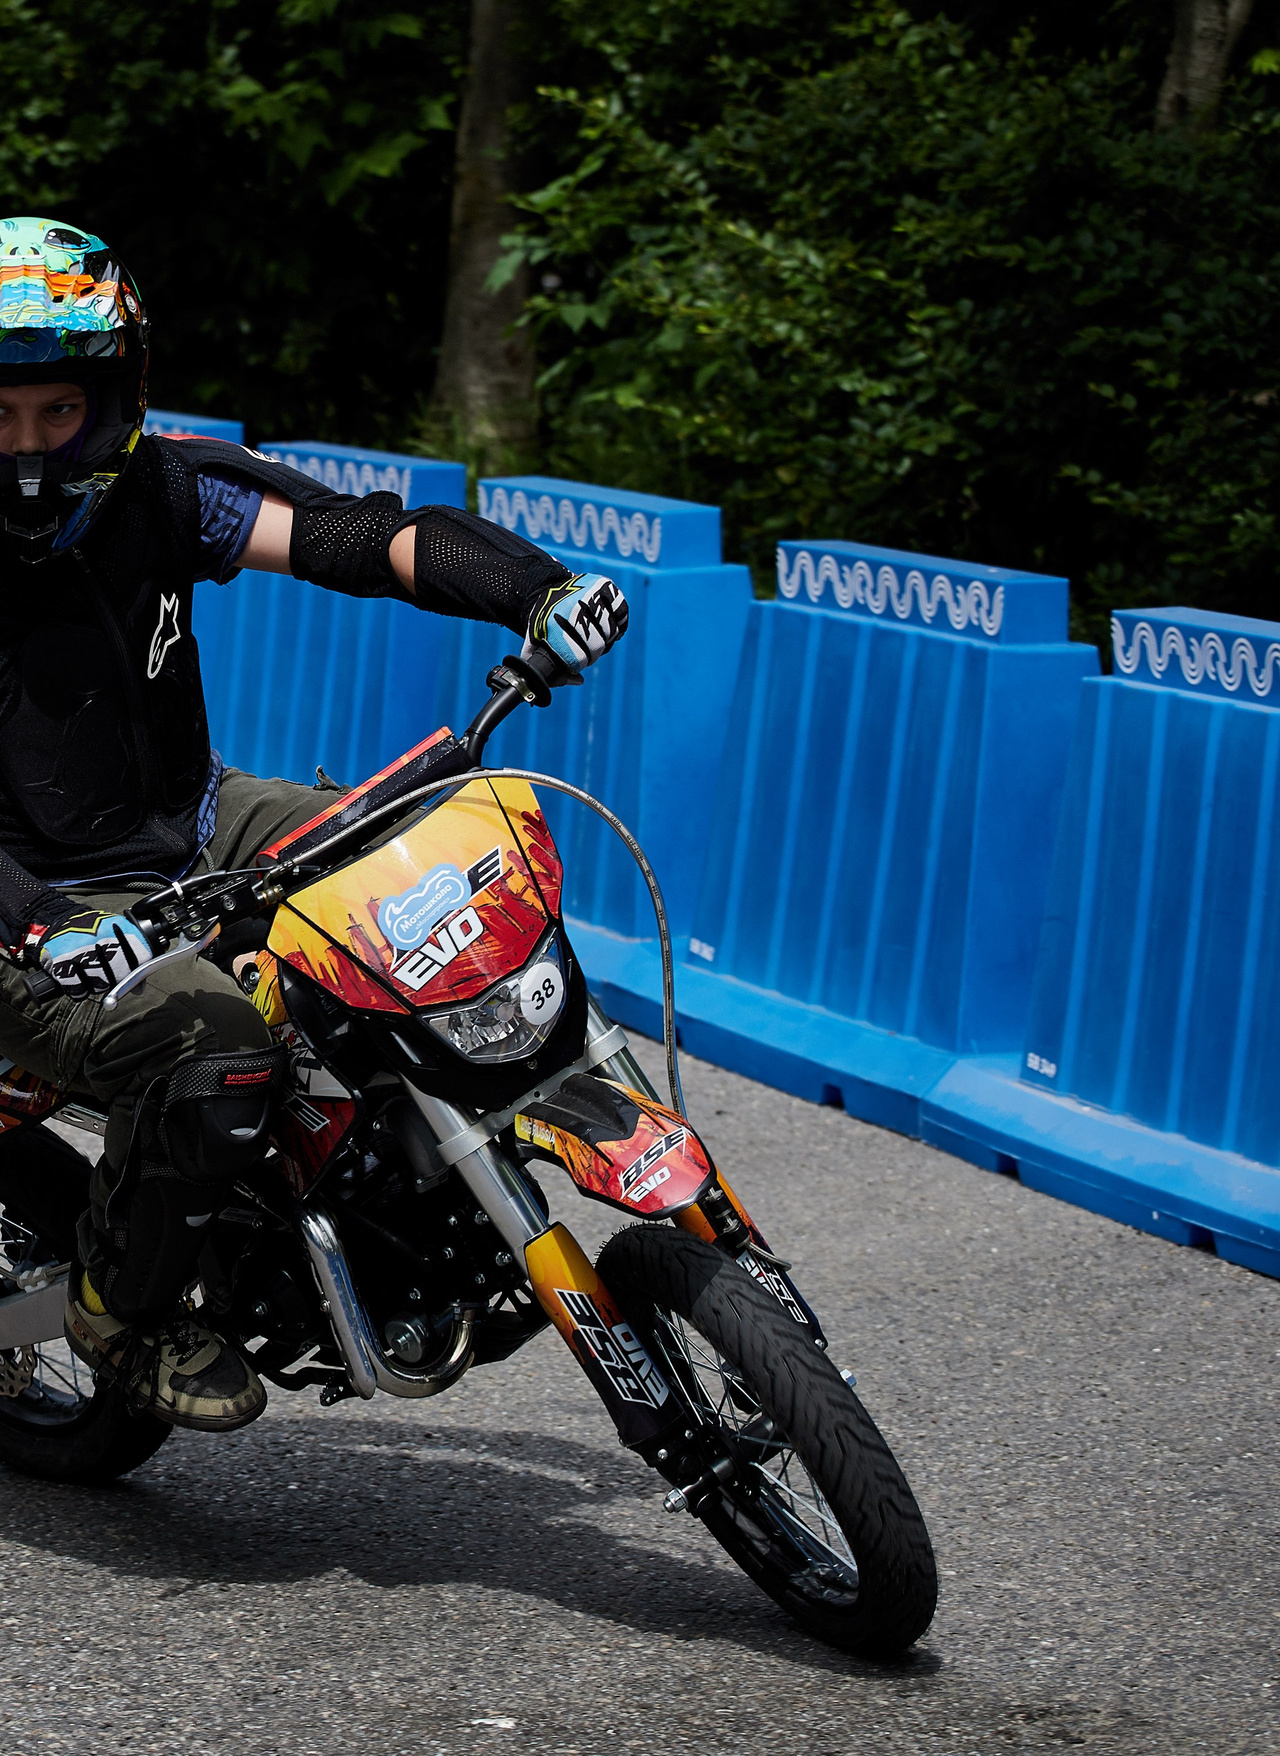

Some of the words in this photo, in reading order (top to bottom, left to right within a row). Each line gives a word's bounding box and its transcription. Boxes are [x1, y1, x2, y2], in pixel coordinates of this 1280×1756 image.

[400, 884, 453, 933] Мотошкола
[392, 905, 484, 992] EVO
[532, 978, 555, 1011] 38
[531, 1123, 556, 1145] RUSSIA
[621, 1127, 687, 1198] BSE
[627, 1166, 671, 1203] EVO
[182, 1344, 200, 1359] NIKE
[554, 1288, 659, 1410] BSE
[612, 1322, 670, 1407] EVO
